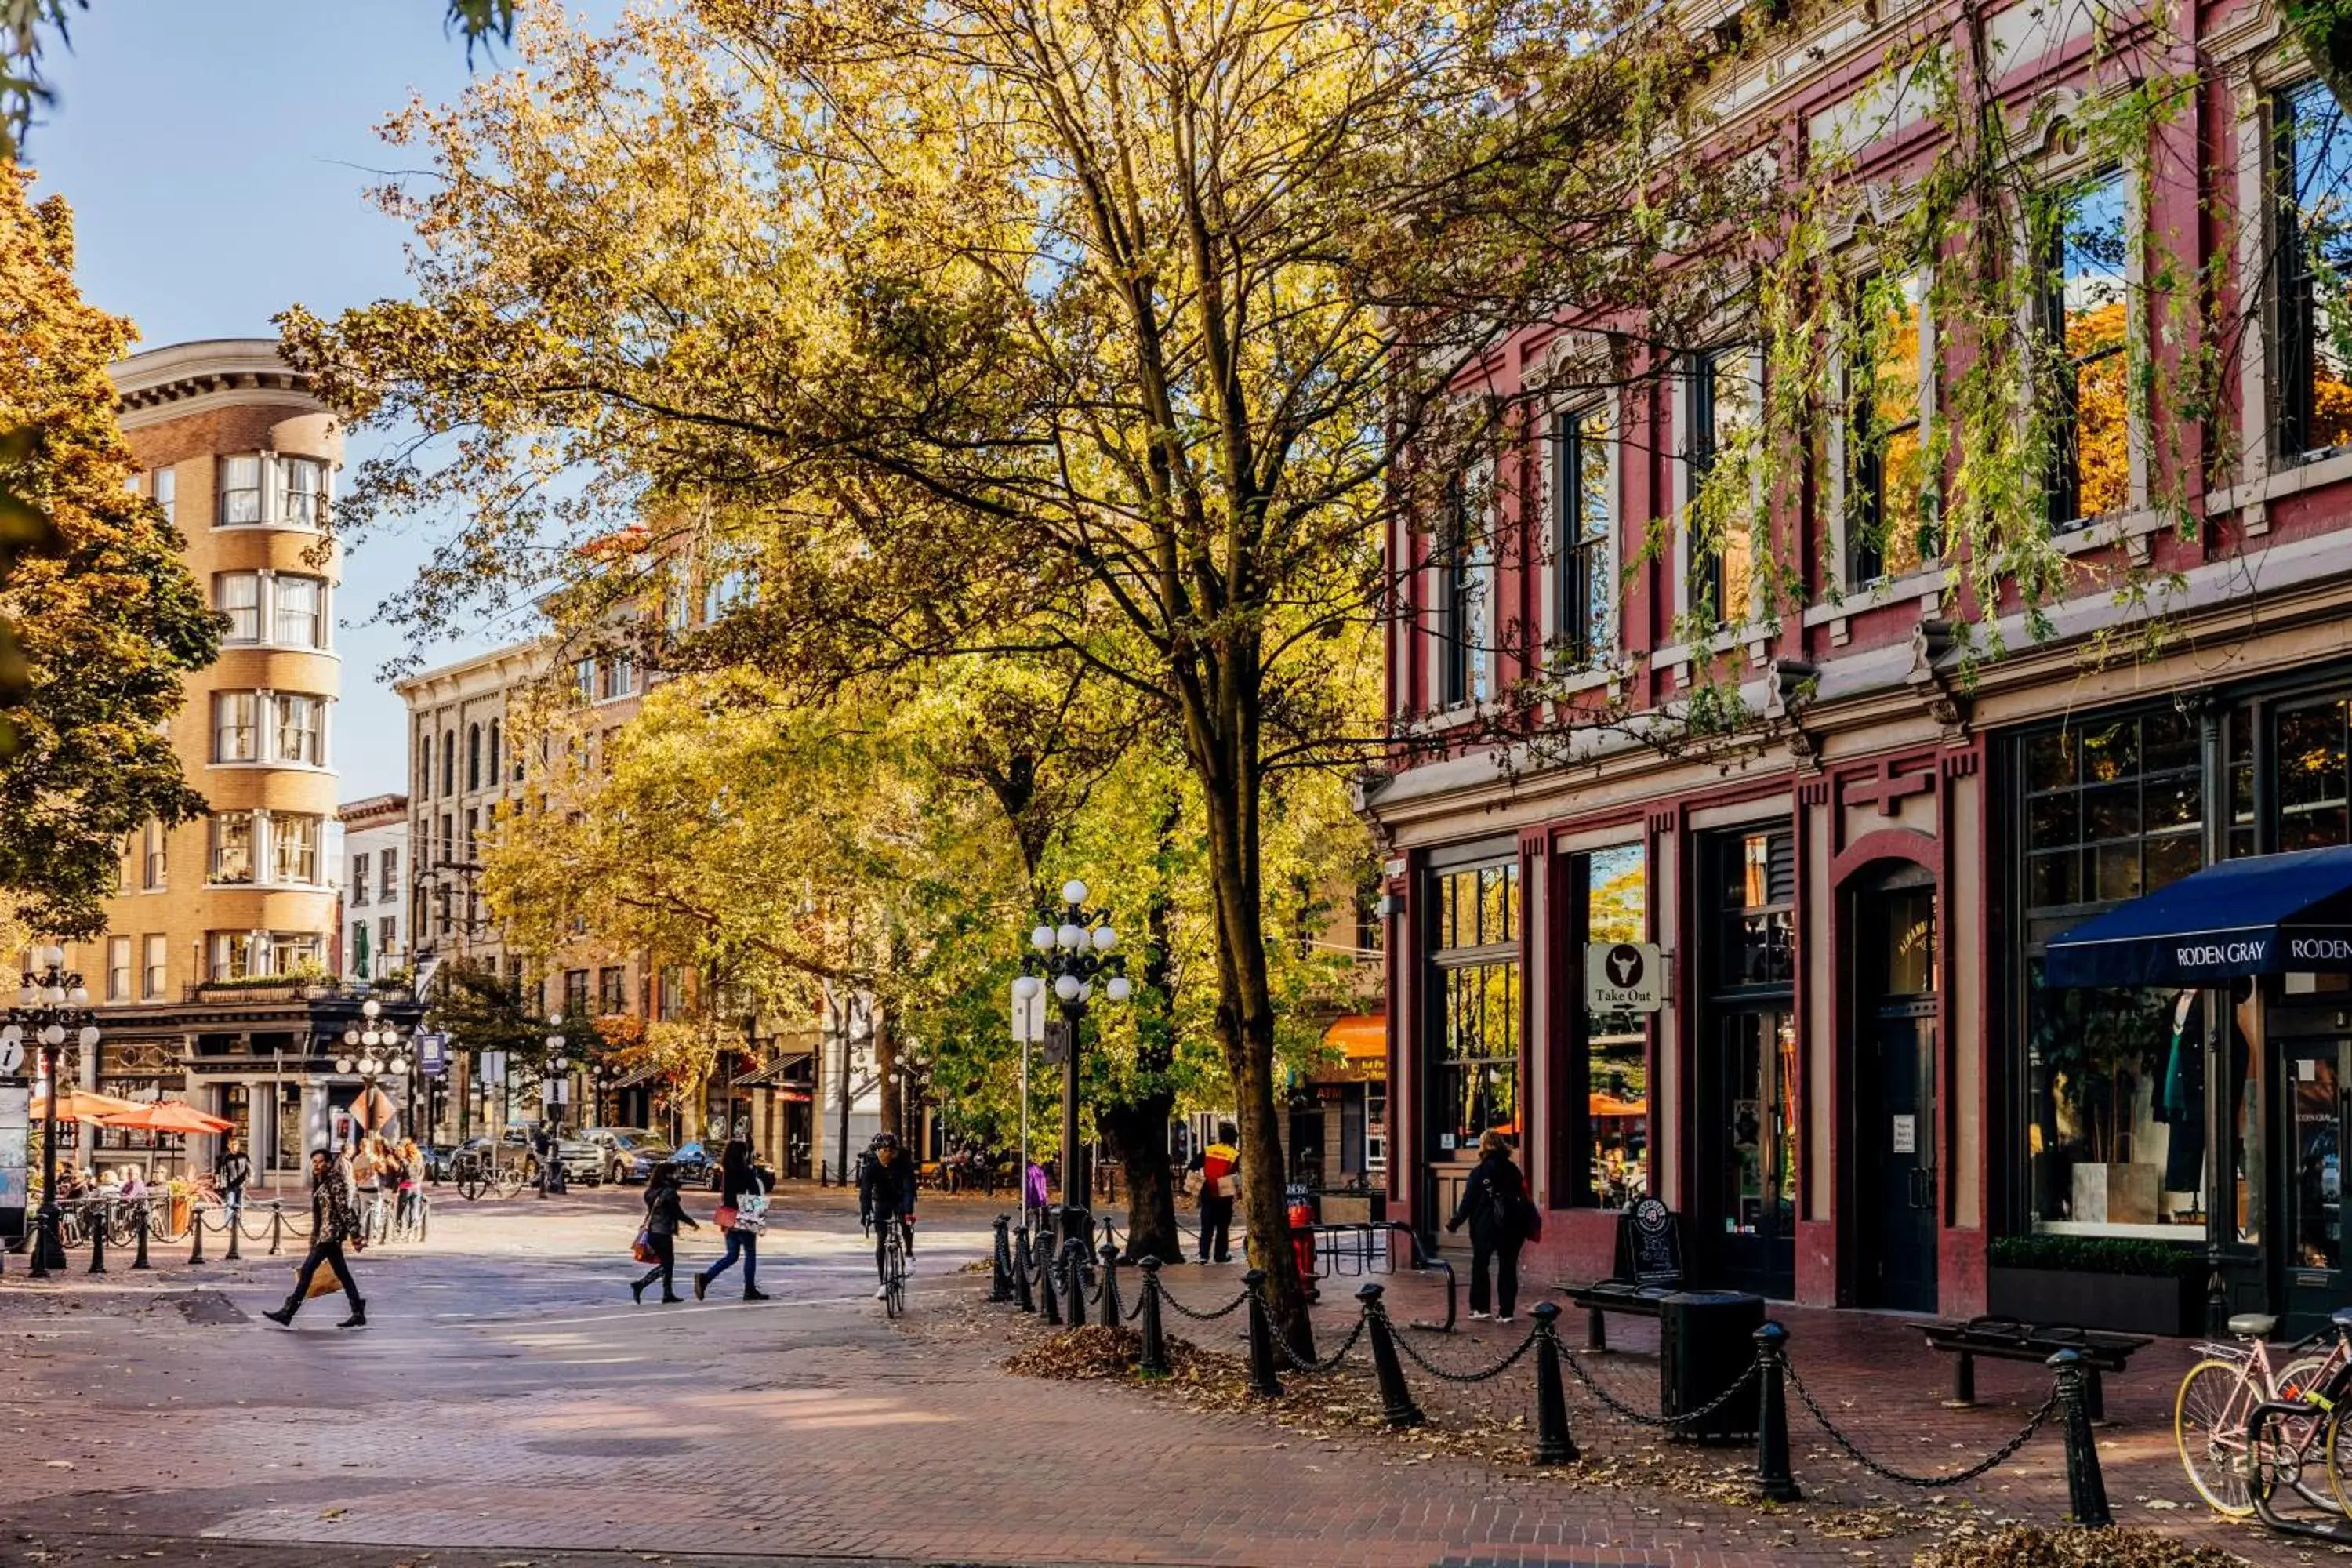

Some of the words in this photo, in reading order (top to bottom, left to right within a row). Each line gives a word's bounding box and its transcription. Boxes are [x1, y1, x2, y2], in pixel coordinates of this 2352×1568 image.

[2176, 946, 2225, 966] RODEN
[2227, 941, 2266, 963] GRAY
[1595, 989, 1625, 1001] Take
[1628, 989, 1651, 1001] Out
[1317, 1087, 1341, 1098] ATM
